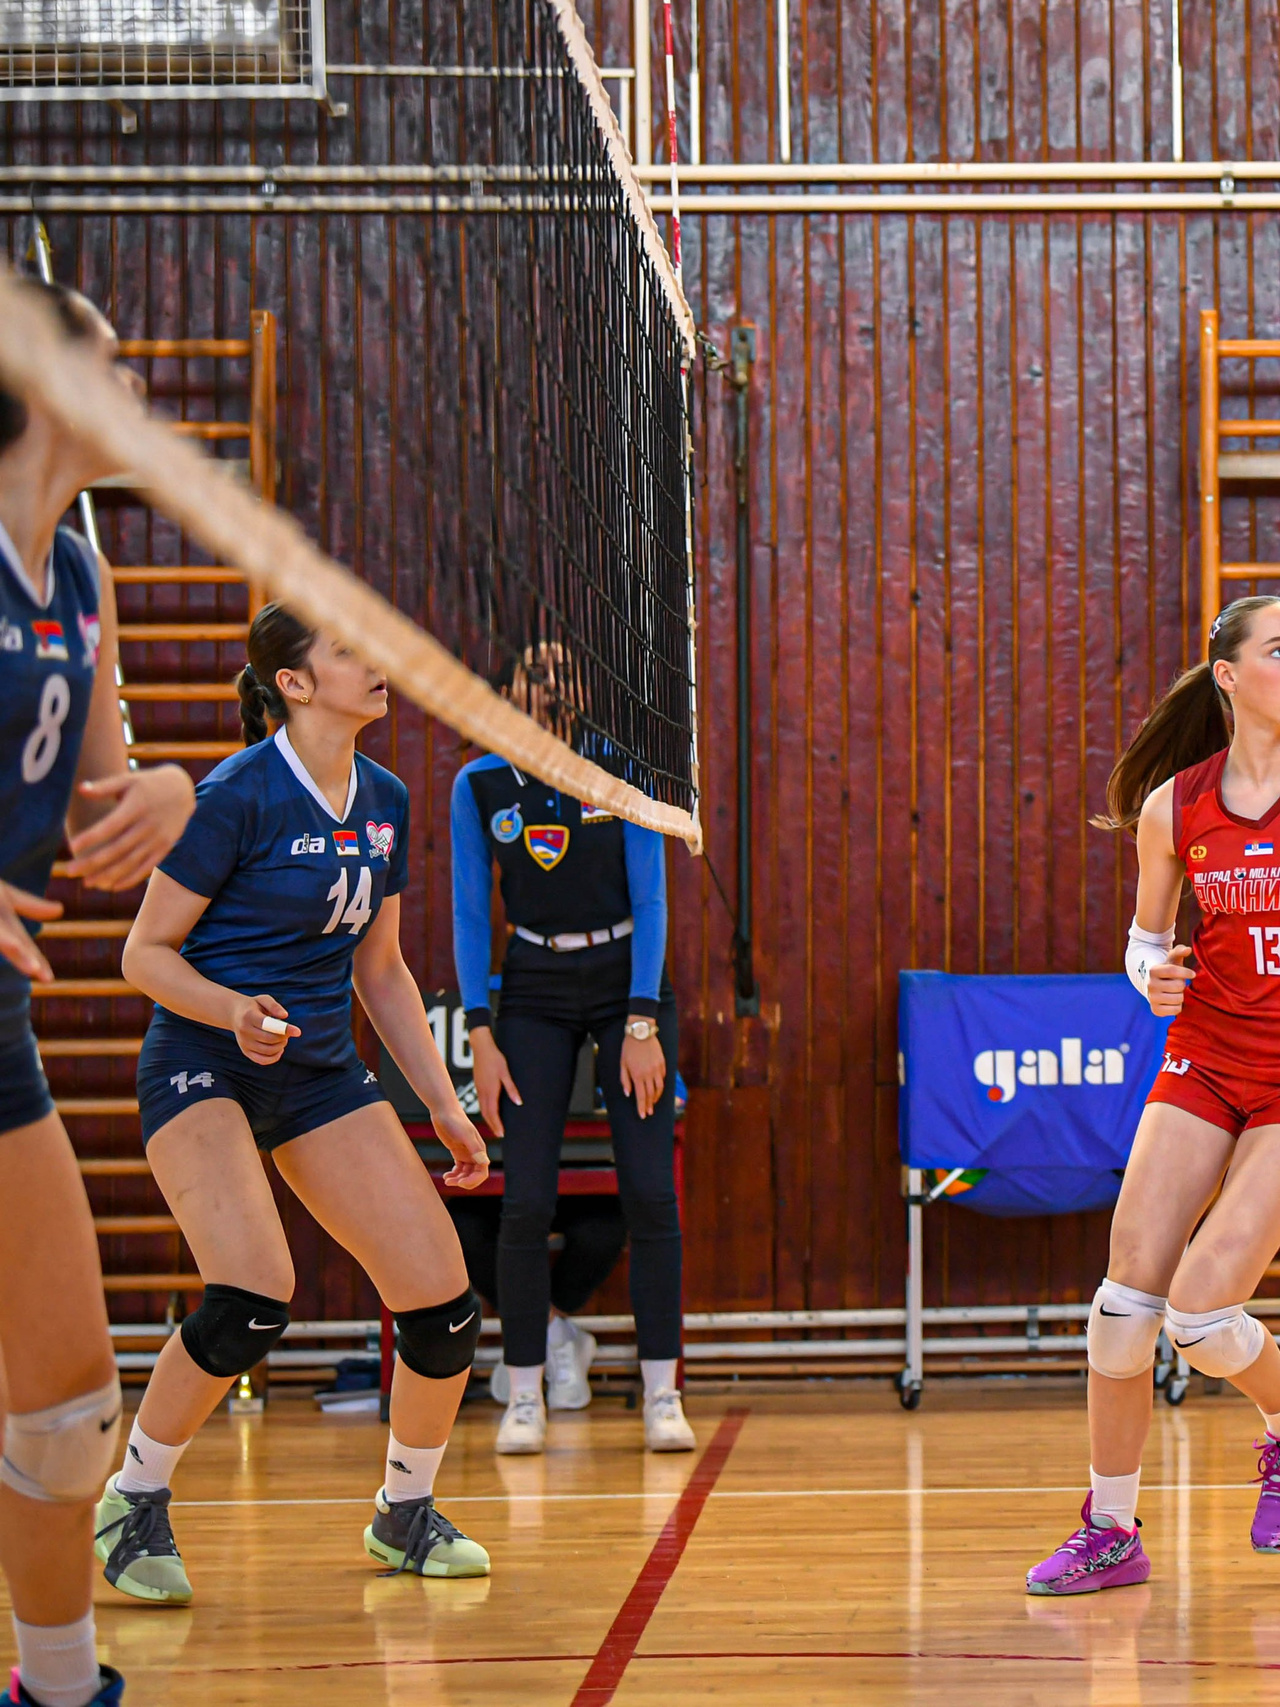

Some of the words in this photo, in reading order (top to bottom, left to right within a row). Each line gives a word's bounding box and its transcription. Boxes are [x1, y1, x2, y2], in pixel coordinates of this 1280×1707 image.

[21, 673, 71, 784] 8
[321, 866, 373, 936] 14
[1207, 870, 1232, 883] ГРАД
[1249, 867, 1269, 879] МОЈ
[169, 1070, 216, 1095] 14
[973, 1037, 1125, 1104] gala
